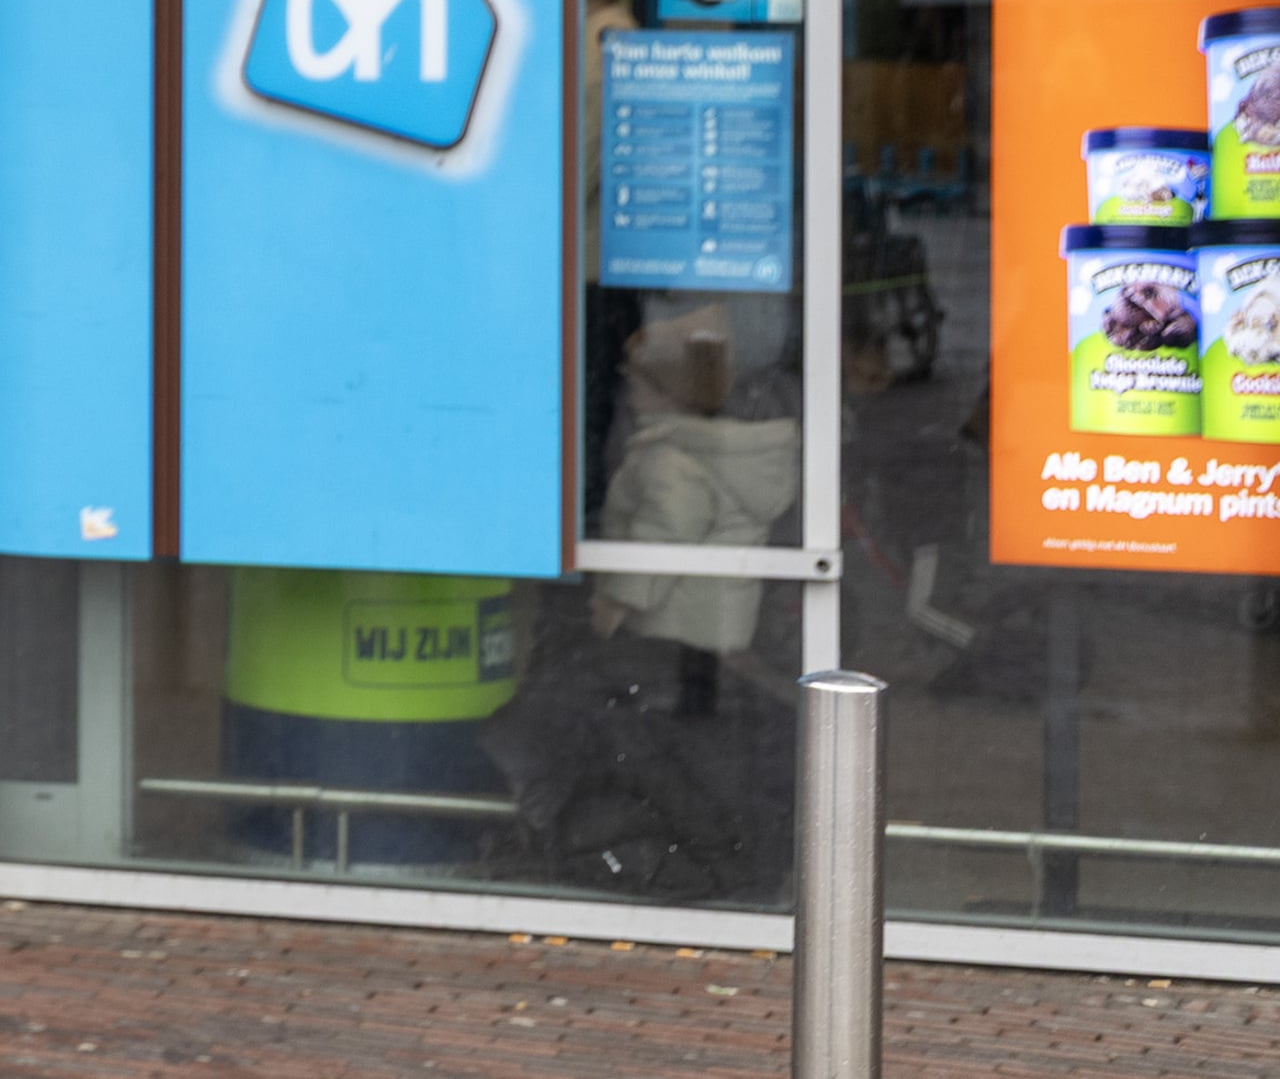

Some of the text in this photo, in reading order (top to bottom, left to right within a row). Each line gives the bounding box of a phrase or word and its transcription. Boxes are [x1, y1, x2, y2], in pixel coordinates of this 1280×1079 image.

[1105, 353, 1188, 376] Chocolate
[1041, 451, 1098, 482] Alle
[1103, 455, 1161, 484] Ben
[1166, 457, 1193, 486] &
[1041, 486, 1081, 512] en
[1086, 484, 1214, 520] Magnum
[354, 625, 408, 661] WIJ
[414, 625, 472, 663] ZIJN
